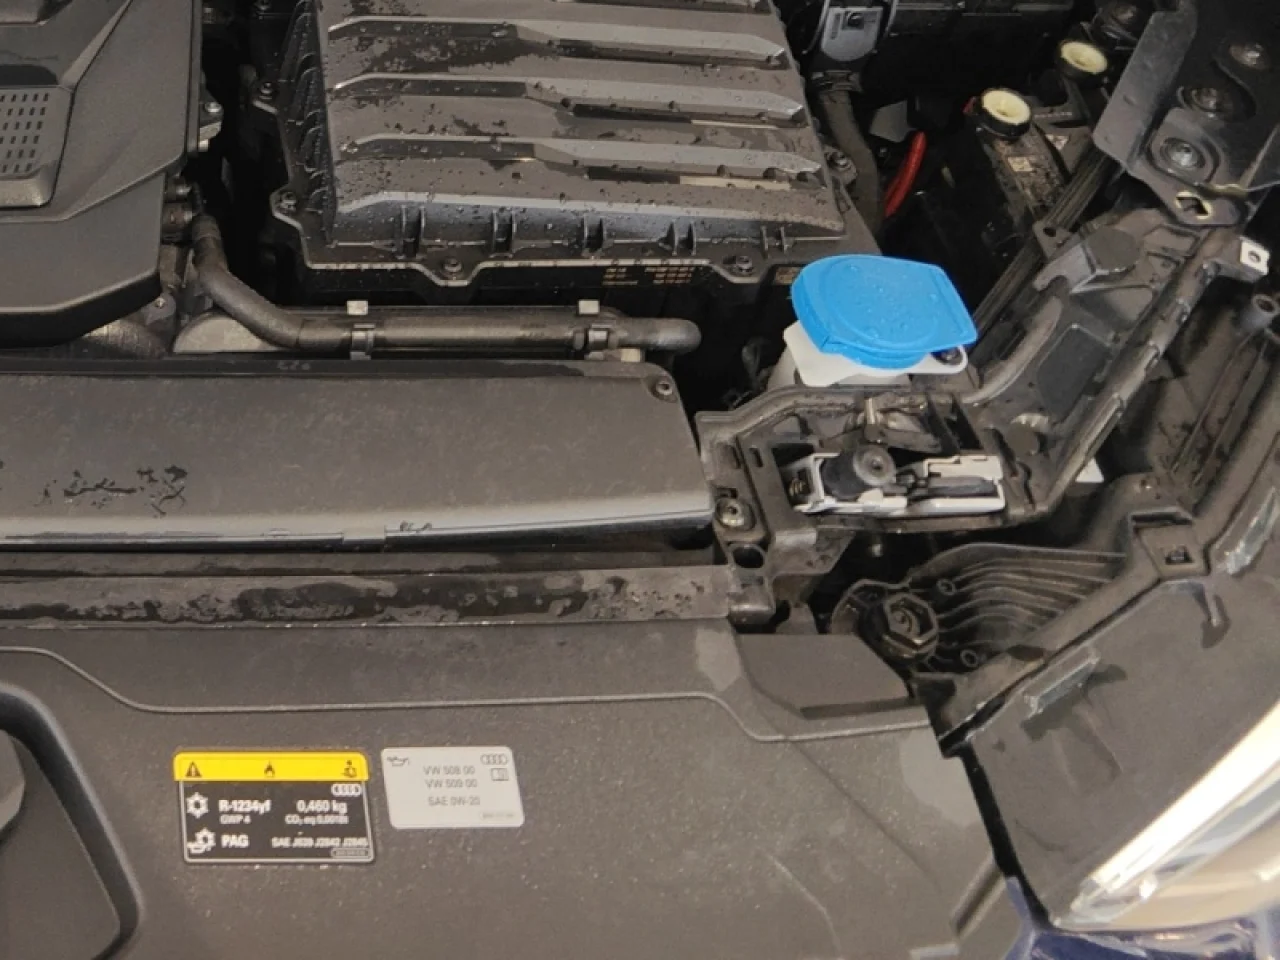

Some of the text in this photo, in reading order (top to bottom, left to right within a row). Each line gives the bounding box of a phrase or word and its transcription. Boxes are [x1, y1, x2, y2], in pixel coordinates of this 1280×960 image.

[423, 765, 440, 776] VW
[463, 765, 476, 775] 00
[425, 778, 442, 789] VW
[465, 778, 478, 788] 00
[331, 799, 348, 814] kg
[428, 796, 448, 806] SAE
[221, 833, 250, 848] PAG
